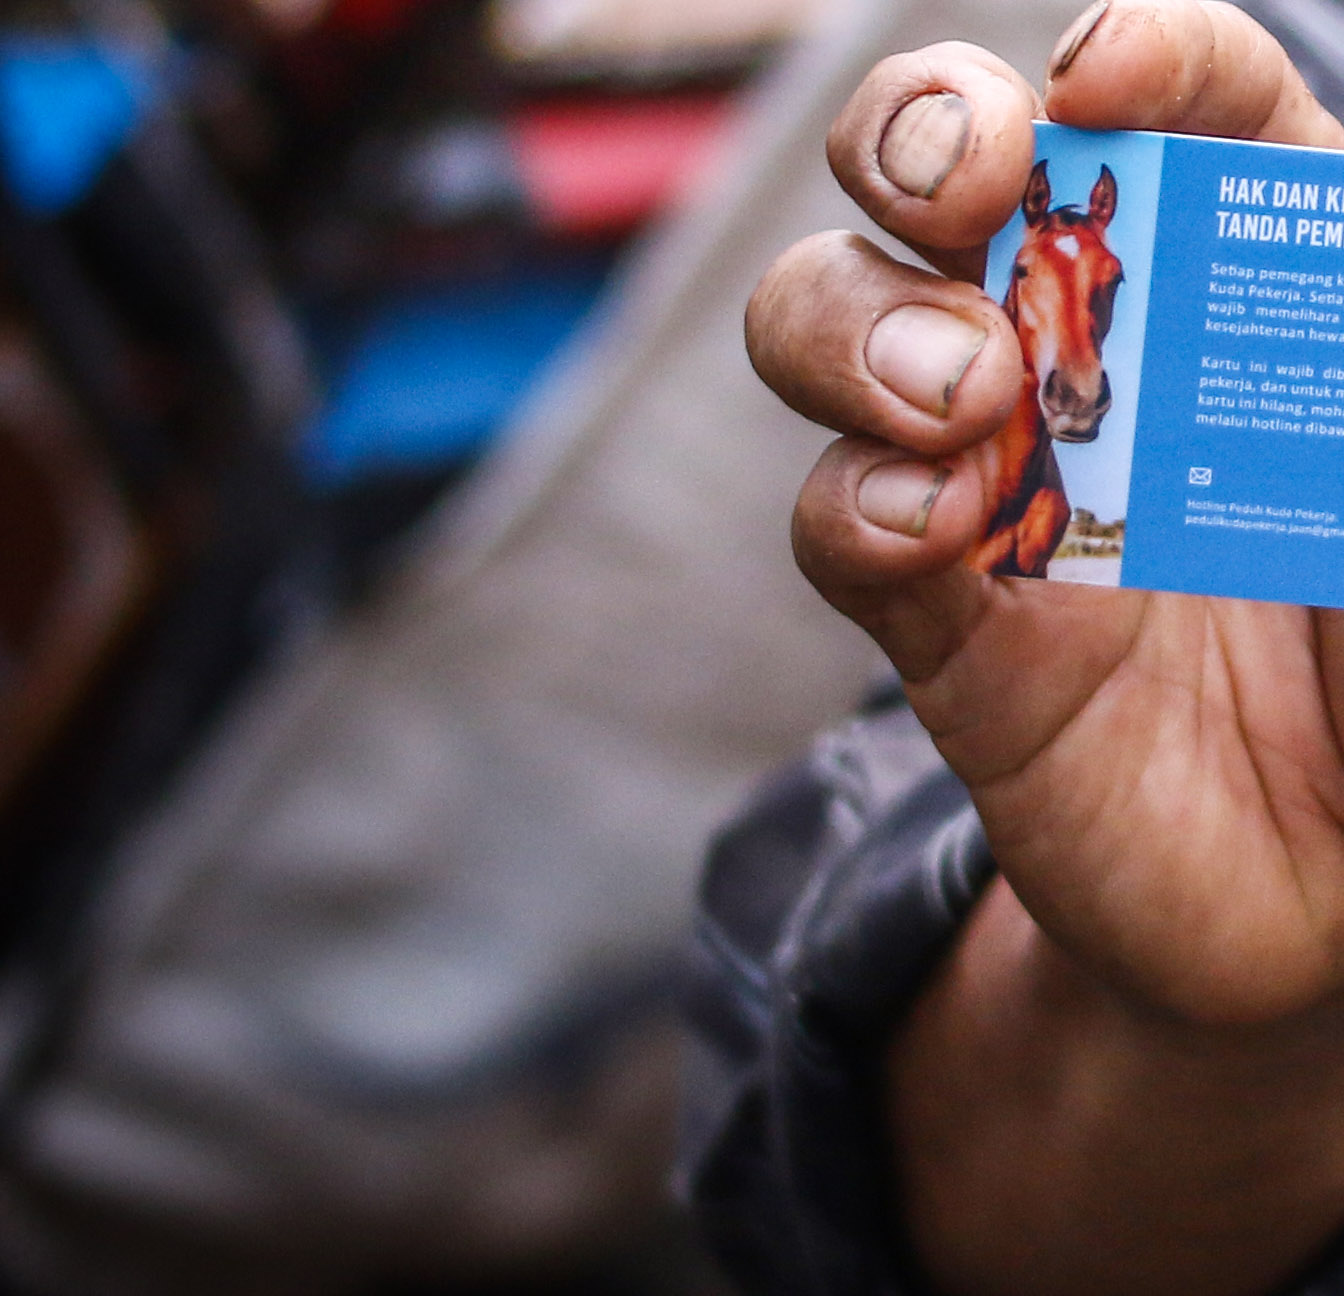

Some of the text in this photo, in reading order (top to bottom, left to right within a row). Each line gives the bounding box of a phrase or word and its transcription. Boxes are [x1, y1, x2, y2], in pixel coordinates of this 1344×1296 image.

[1219, 176, 1267, 206] HAK
[1273, 181, 1319, 210] DAN
[1216, 211, 1288, 243] TANDA
[1210, 262, 1255, 280] Setiap
[1259, 270, 1333, 288] pemegang
[1208, 281, 1244, 296] Kuda
[1248, 285, 1304, 303] Pekerja.
[1207, 302, 1246, 316] wajib
[1255, 307, 1340, 323] memelihara
[1205, 318, 1305, 339] kesejahteraan
[1201, 356, 1240, 371] Kartu
[1249, 361, 1267, 373] ini
[1276, 365, 1314, 379] wajib
[1199, 376, 1256, 392] pekerja,
[1260, 380, 1287, 393] dan
[1291, 385, 1331, 398] untuk
[1197, 392, 1235, 408] kartu
[1239, 397, 1256, 409] ini
[1260, 398, 1307, 416] hilang,
[1195, 413, 1248, 428] melalui
[1251, 416, 1302, 433] hotline
[1187, 499, 1226, 512] Hotline
[1229, 503, 1264, 515] Peduli
[1265, 506, 1293, 518] Kuda
